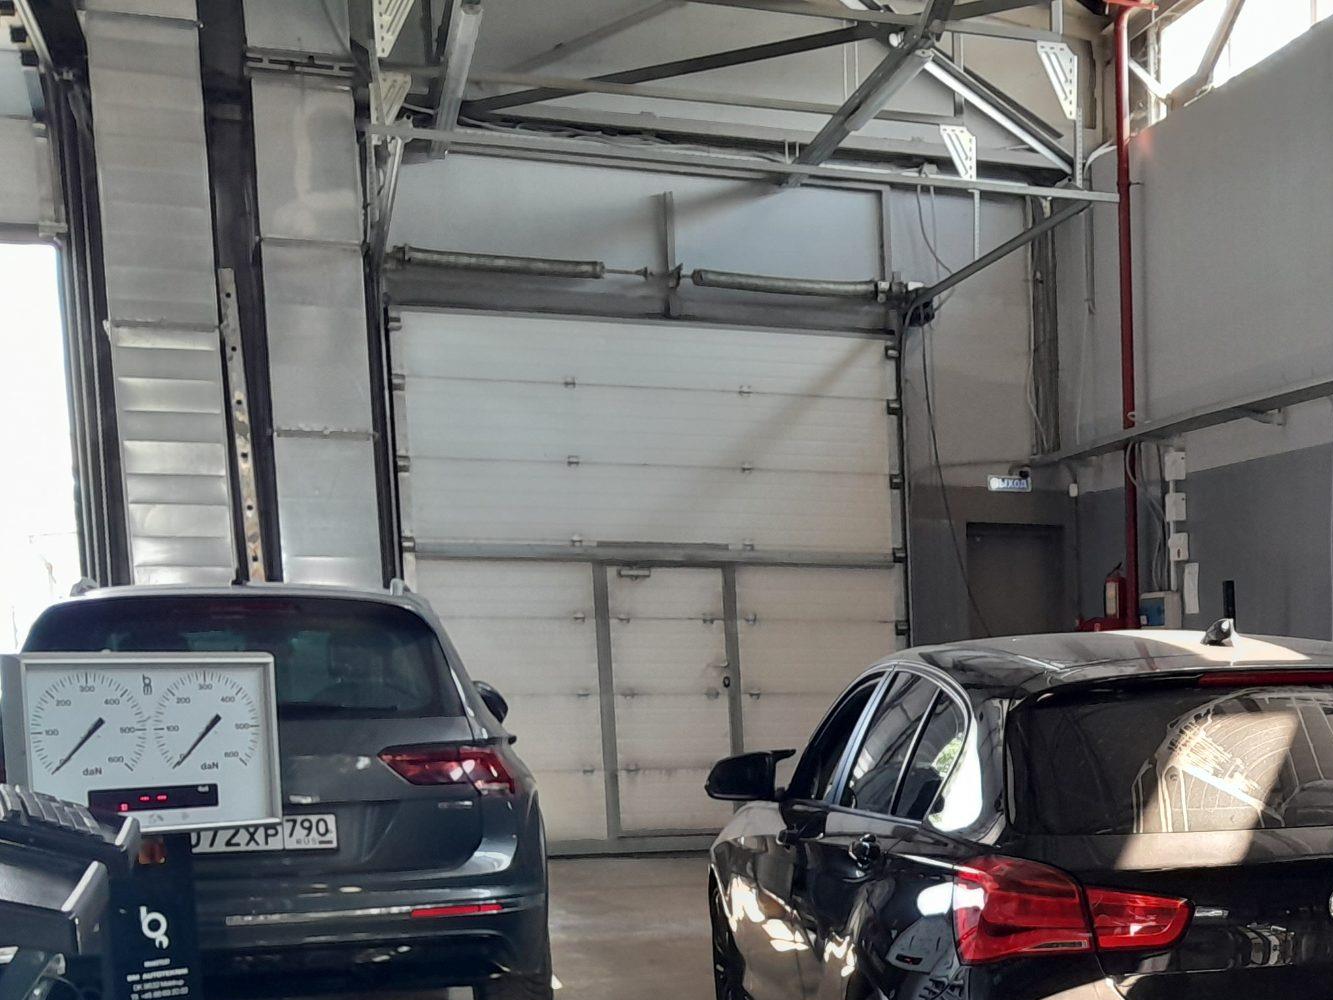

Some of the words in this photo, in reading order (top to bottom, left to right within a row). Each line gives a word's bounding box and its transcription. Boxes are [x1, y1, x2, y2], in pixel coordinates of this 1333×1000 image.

[991, 478, 1027, 489] ЫХОД
[200, 762, 219, 770] daN
[82, 767, 102, 776] daN
[285, 818, 328, 838] 790
